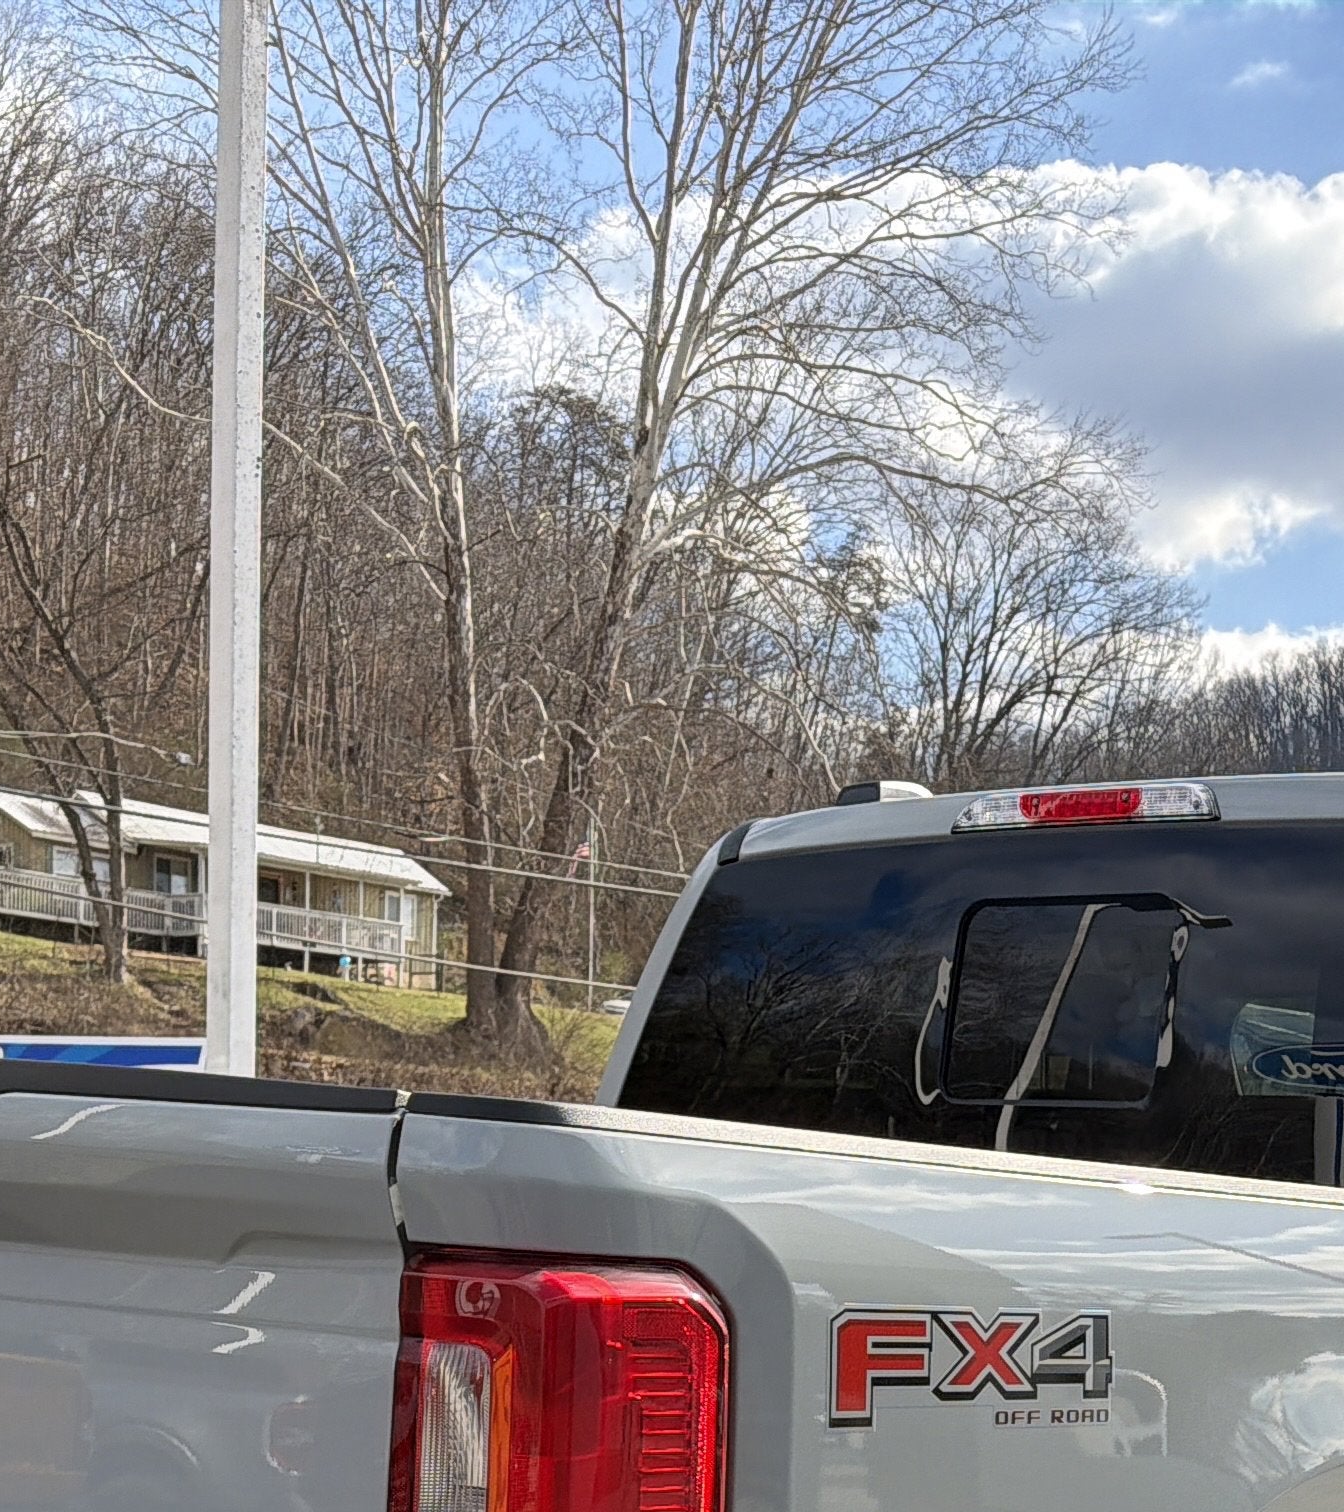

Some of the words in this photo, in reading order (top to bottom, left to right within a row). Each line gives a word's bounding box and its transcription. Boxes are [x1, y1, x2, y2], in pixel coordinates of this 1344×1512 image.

[828, 1308, 1113, 1429] FX4
[994, 1409, 1042, 1426] OFF
[1050, 1407, 1111, 1425] ROAD
